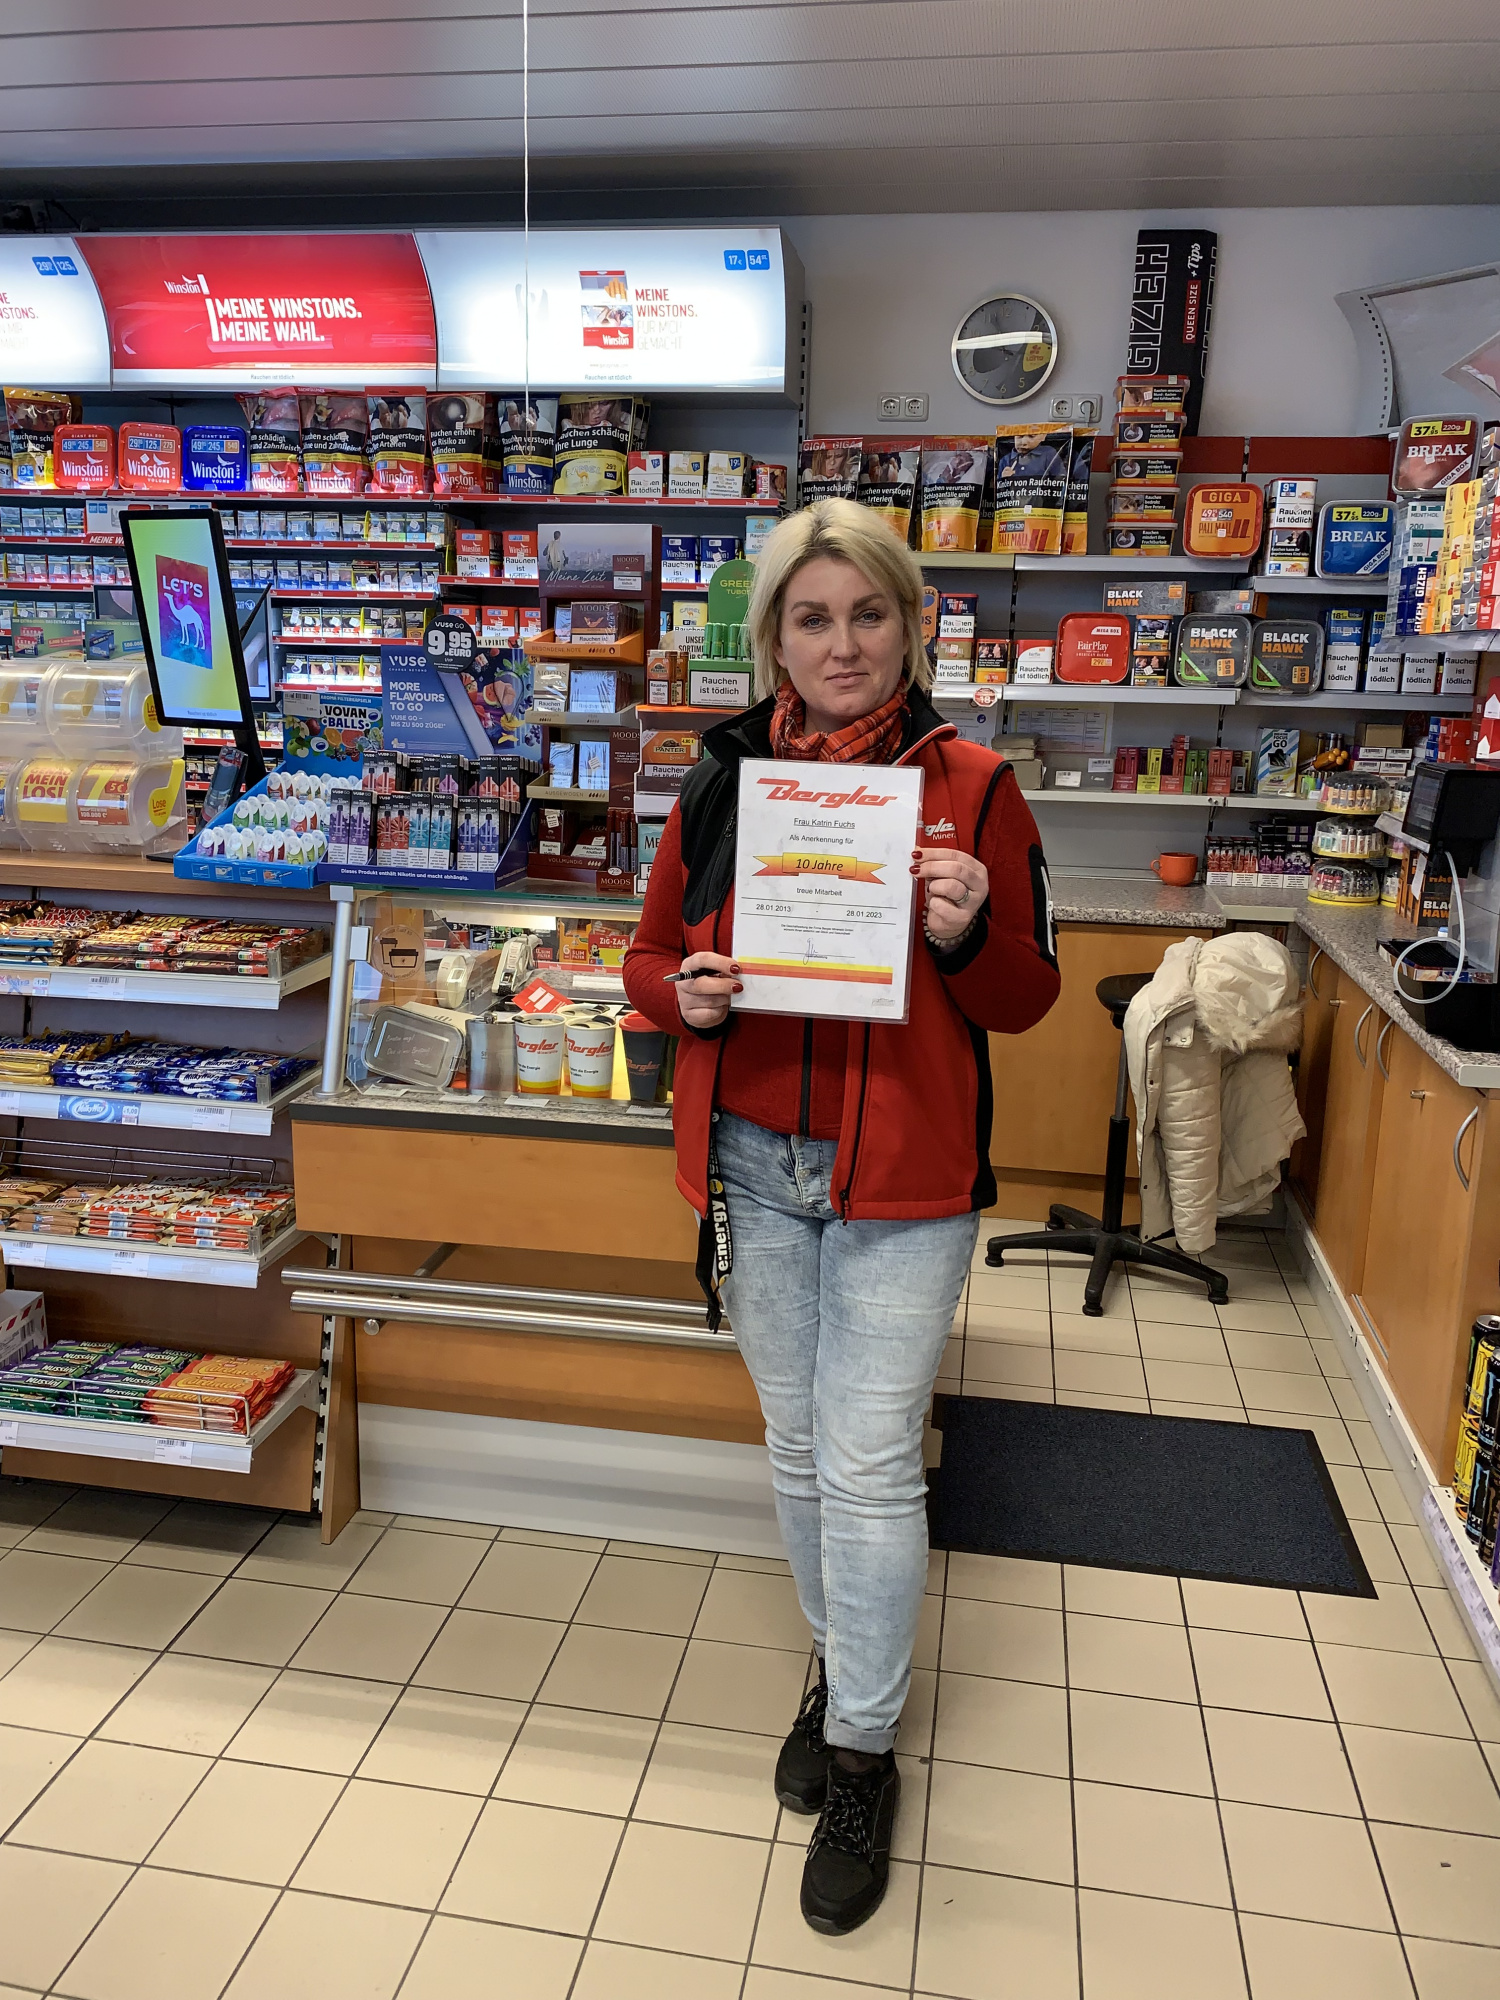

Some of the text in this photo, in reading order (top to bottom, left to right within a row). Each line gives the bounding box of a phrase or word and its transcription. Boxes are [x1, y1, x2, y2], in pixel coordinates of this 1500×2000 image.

[635, 288, 670, 301] MEINE
[215, 298, 362, 318] MEINE WINSTONS.
[637, 304, 698, 317] WINSTONS.
[1127, 243, 1170, 376] GIZEH
[1185, 284, 1198, 341] QUEEN SIZE
[220, 321, 325, 342] MEINE WAHL.
[1000, 383, 1006, 393] 6
[258, 434, 286, 443] schädigt
[591, 427, 629, 442] schädigt
[571, 438, 598, 449] Lunge
[803, 441, 826, 451] GIGA
[1406, 443, 1469, 458] BREAK
[62, 460, 103, 477] Winston
[127, 459, 170, 479] Winston
[191, 460, 234, 479] Winston
[1440, 461, 1469, 486] GIGA BOX
[309, 472, 351, 489] Winston
[380, 470, 414, 484] Winston
[508, 474, 542, 489] Winston
[670, 479, 700, 487] Rauchen
[1014, 478, 1065, 487] von Rauchern
[639, 486, 661, 494] tödlich
[678, 487, 700, 495] tödlich
[826, 483, 855, 494] schädigt
[881, 487, 912, 497] verstopft
[946, 485, 976, 493] verursacht
[1015, 487, 1062, 497] oft selbst zu
[1209, 492, 1242, 502] GIGA
[1276, 515, 1313, 524] ist tödlich
[89, 535, 114, 544] MEINE
[1330, 531, 1387, 543] BREAK
[545, 569, 606, 586] Meine Zeit
[1415, 567, 1428, 597] GIZEH
[162, 575, 204, 598] LET'S
[1107, 590, 1143, 598] BLACK
[579, 604, 610, 612] MOODS
[1107, 599, 1139, 607] HAWK
[1190, 627, 1239, 639] BLACK
[1262, 632, 1310, 643] BLACK
[1190, 638, 1233, 649] HAWK
[1262, 643, 1304, 653] HAWK
[449, 648, 472, 658] EURO
[1327, 654, 1359, 662] Rauchen
[1369, 655, 1400, 663] Rauchen
[1405, 656, 1437, 664] Rauchen
[1445, 657, 1478, 665] Rauchen
[939, 663, 968, 671] Rauchen
[701, 676, 738, 685] Rauchen
[390, 681, 420, 692] MORE
[711, 686, 739, 695] tödlich
[390, 692, 445, 703] FLAVOURS
[325, 704, 367, 719] VOVAN
[390, 702, 424, 712] TO GO
[328, 717, 365, 730] BALLS
[1272, 739, 1288, 748] GO
[652, 765, 685, 774] Rauchen
[24, 774, 69, 785] MEIN
[756, 777, 898, 809] Bergler
[152, 799, 166, 809] Lose
[793, 818, 855, 829] Frau Katrin Fuchs
[801, 835, 844, 845] Anerkennung
[548, 857, 583, 865] VOLLMUNDIG
[795, 858, 844, 872] 10 Jahre
[443, 873, 469, 881] abhängig.
[600, 877, 631, 886] MOODS
[796, 887, 843, 897] treue Mitarbeit
[756, 903, 791, 912] 28.01.2013
[846, 910, 883, 919] 28.01.2023
[563, 944, 570, 955] 6
[625, 1058, 661, 1072] Bergler
